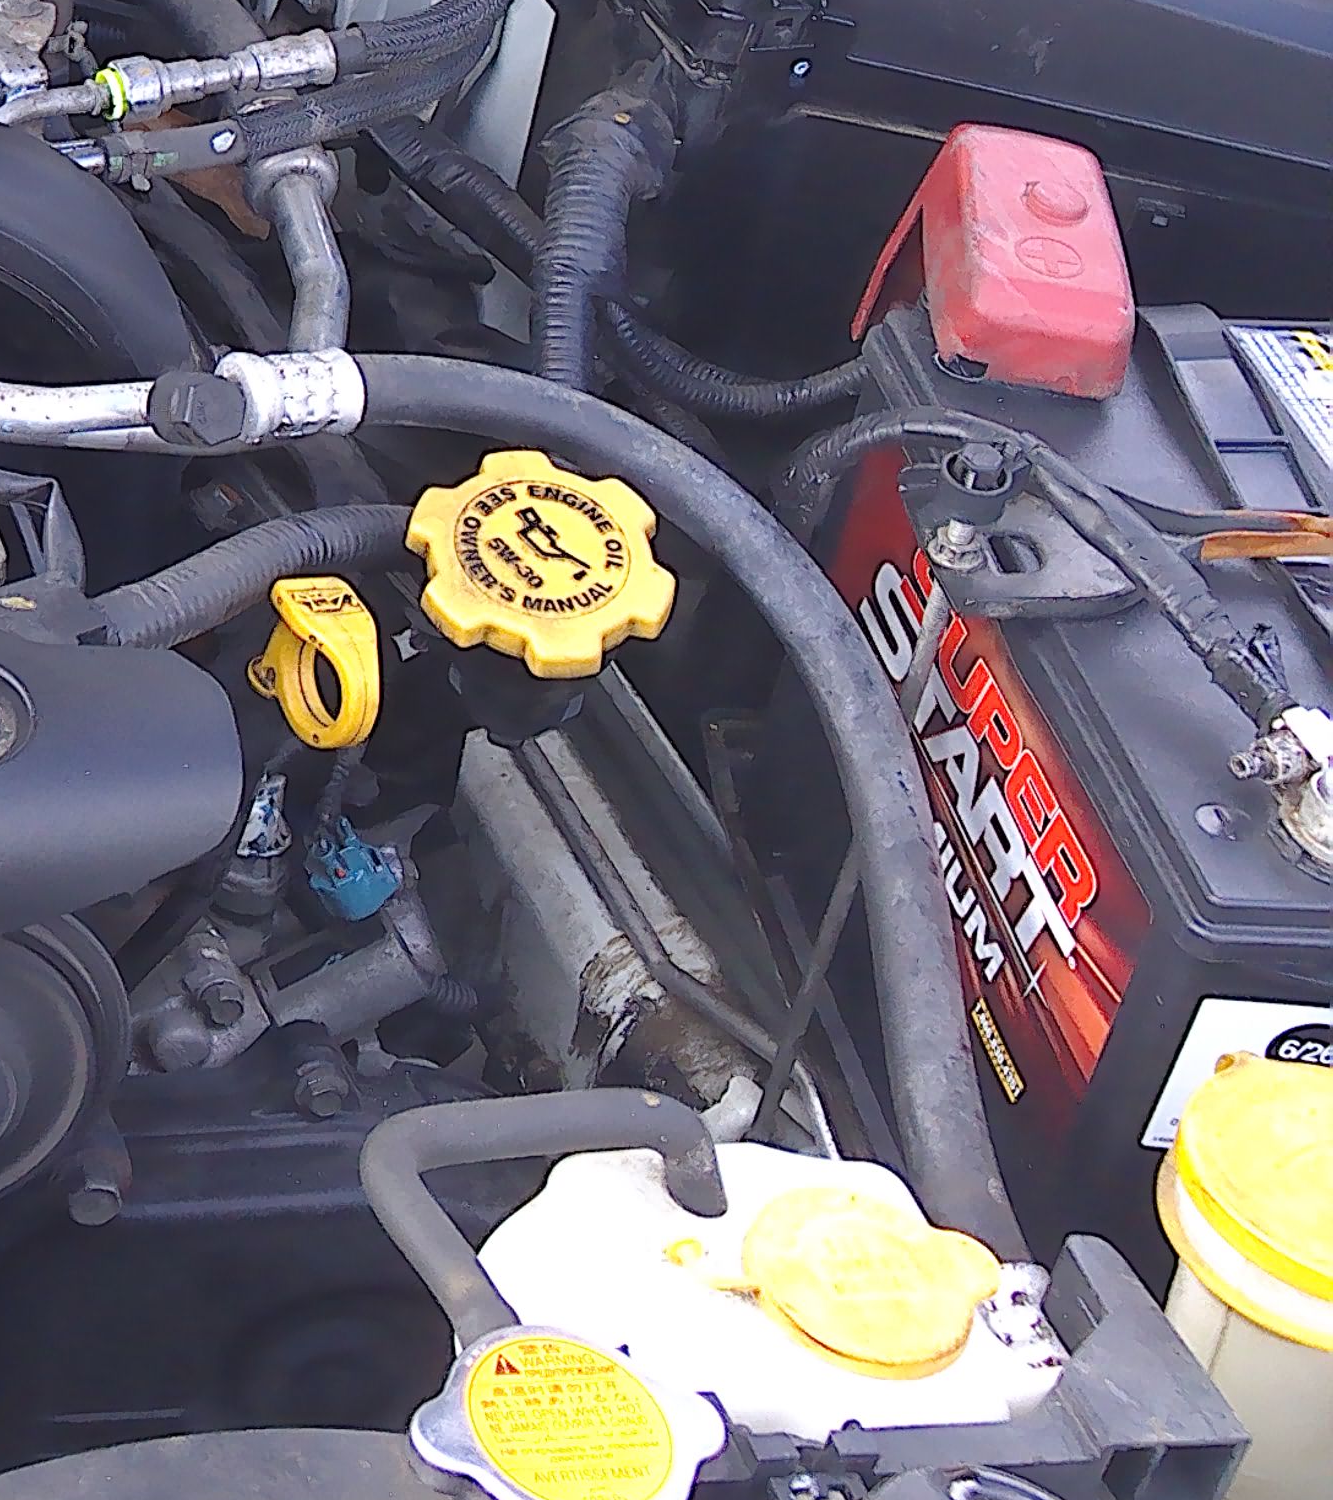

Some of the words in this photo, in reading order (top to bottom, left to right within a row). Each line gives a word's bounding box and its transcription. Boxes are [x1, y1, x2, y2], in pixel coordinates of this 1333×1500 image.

[475, 487, 517, 516] SEE
[527, 484, 613, 535] ENGINE
[605, 538, 624, 570] OIL
[460, 516, 516, 602] OWNER'S
[488, 537, 543, 588] 5W-30
[522, 582, 613, 612] MANUAL
[519, 1353, 595, 1368] WARNING
